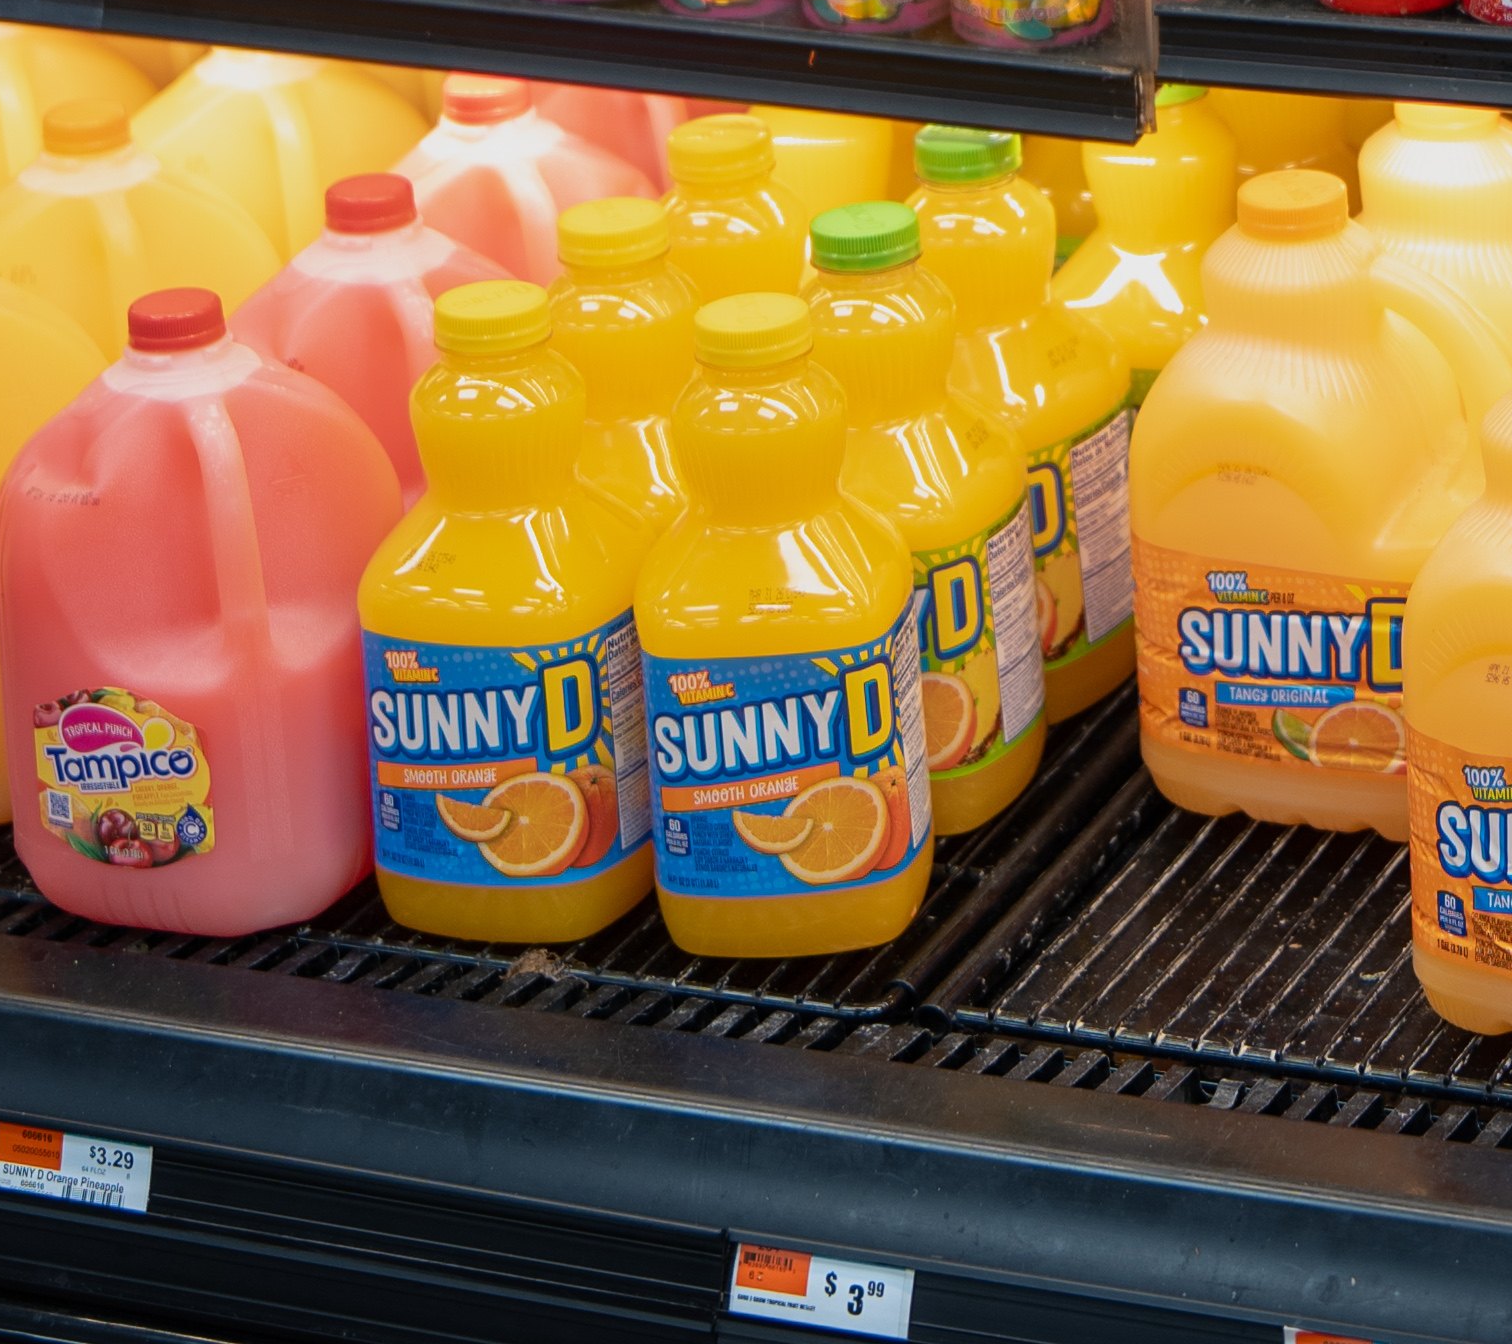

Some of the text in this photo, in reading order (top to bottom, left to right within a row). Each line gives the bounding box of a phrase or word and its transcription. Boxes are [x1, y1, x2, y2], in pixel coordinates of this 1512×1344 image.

[64, 722, 133, 738] TROPICAL PUNCH
[45, 745, 197, 782] Tampico
